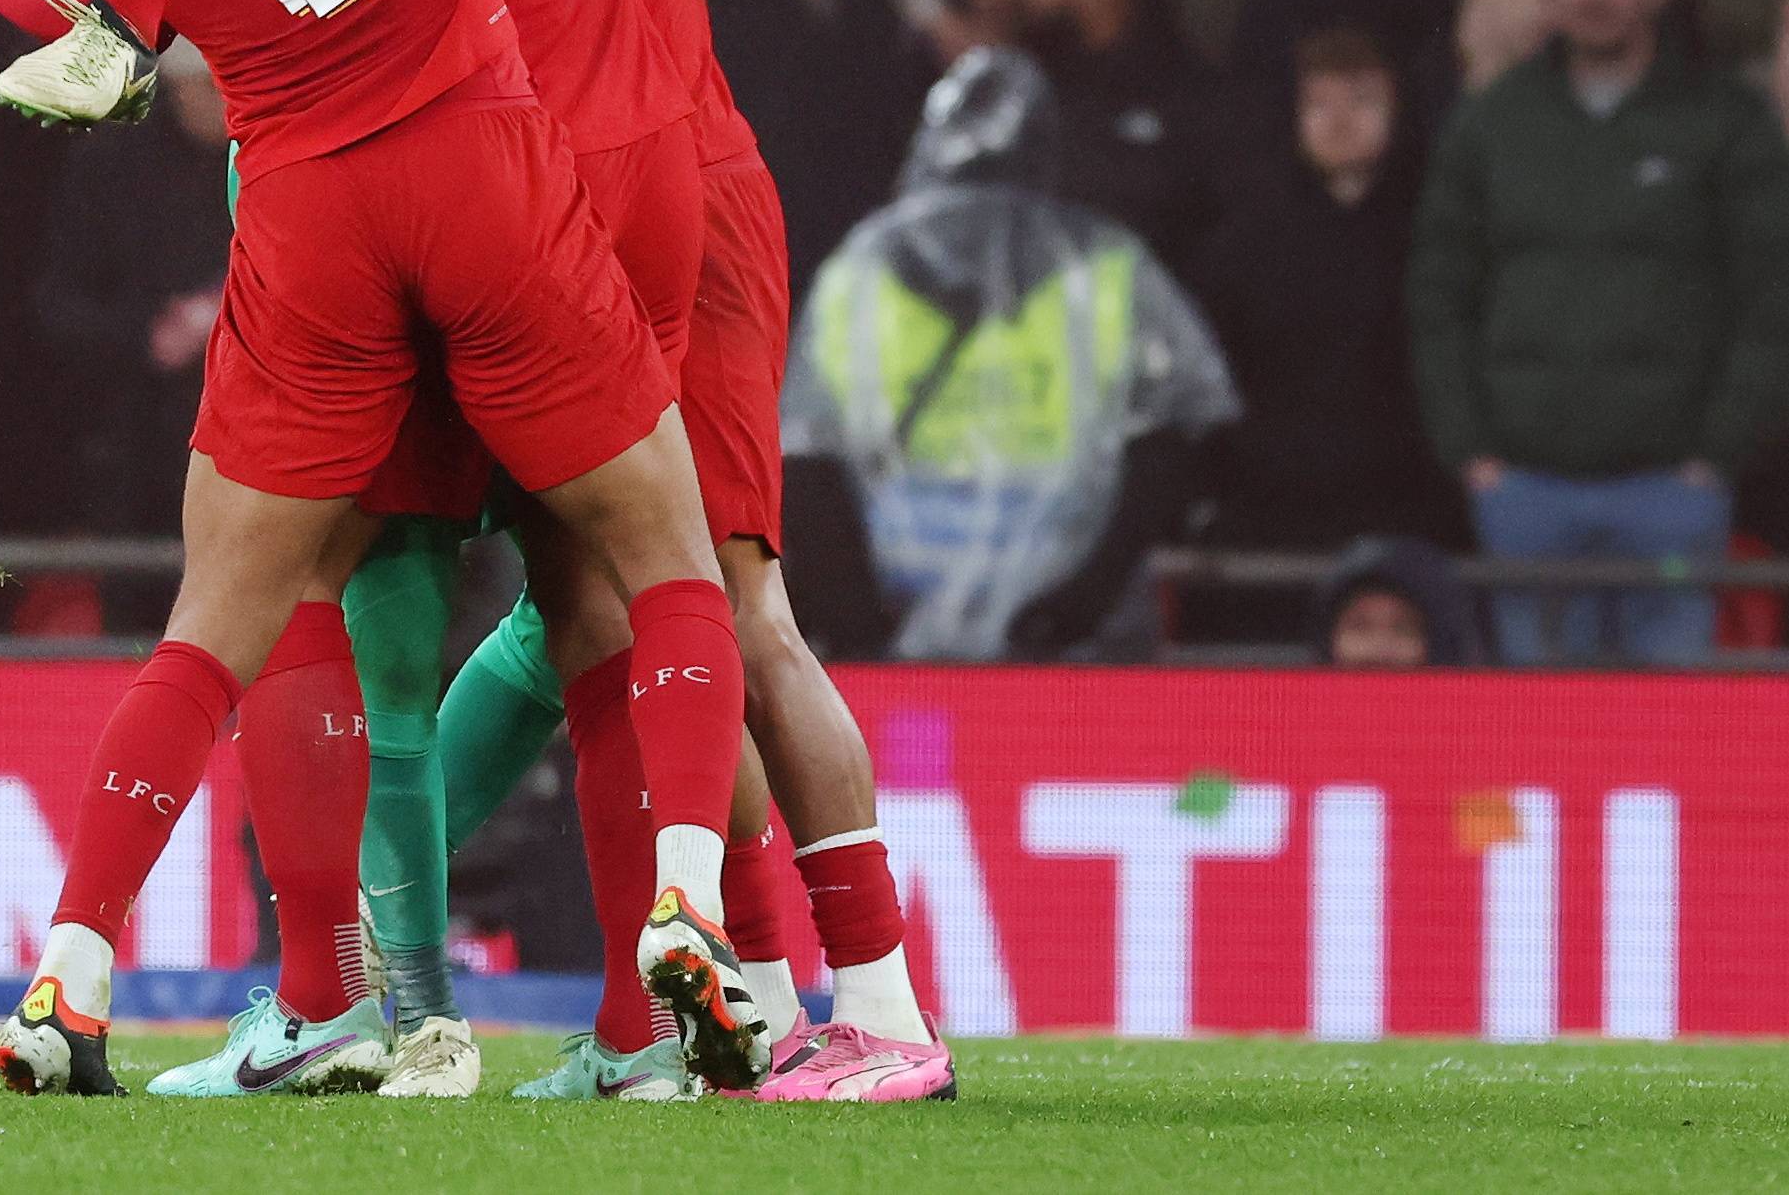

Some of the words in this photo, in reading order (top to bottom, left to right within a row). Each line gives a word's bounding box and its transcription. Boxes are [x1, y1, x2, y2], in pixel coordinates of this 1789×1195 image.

[631, 666, 711, 701] LFC
[321, 712, 369, 738] LF
[102, 771, 176, 815] LFC
